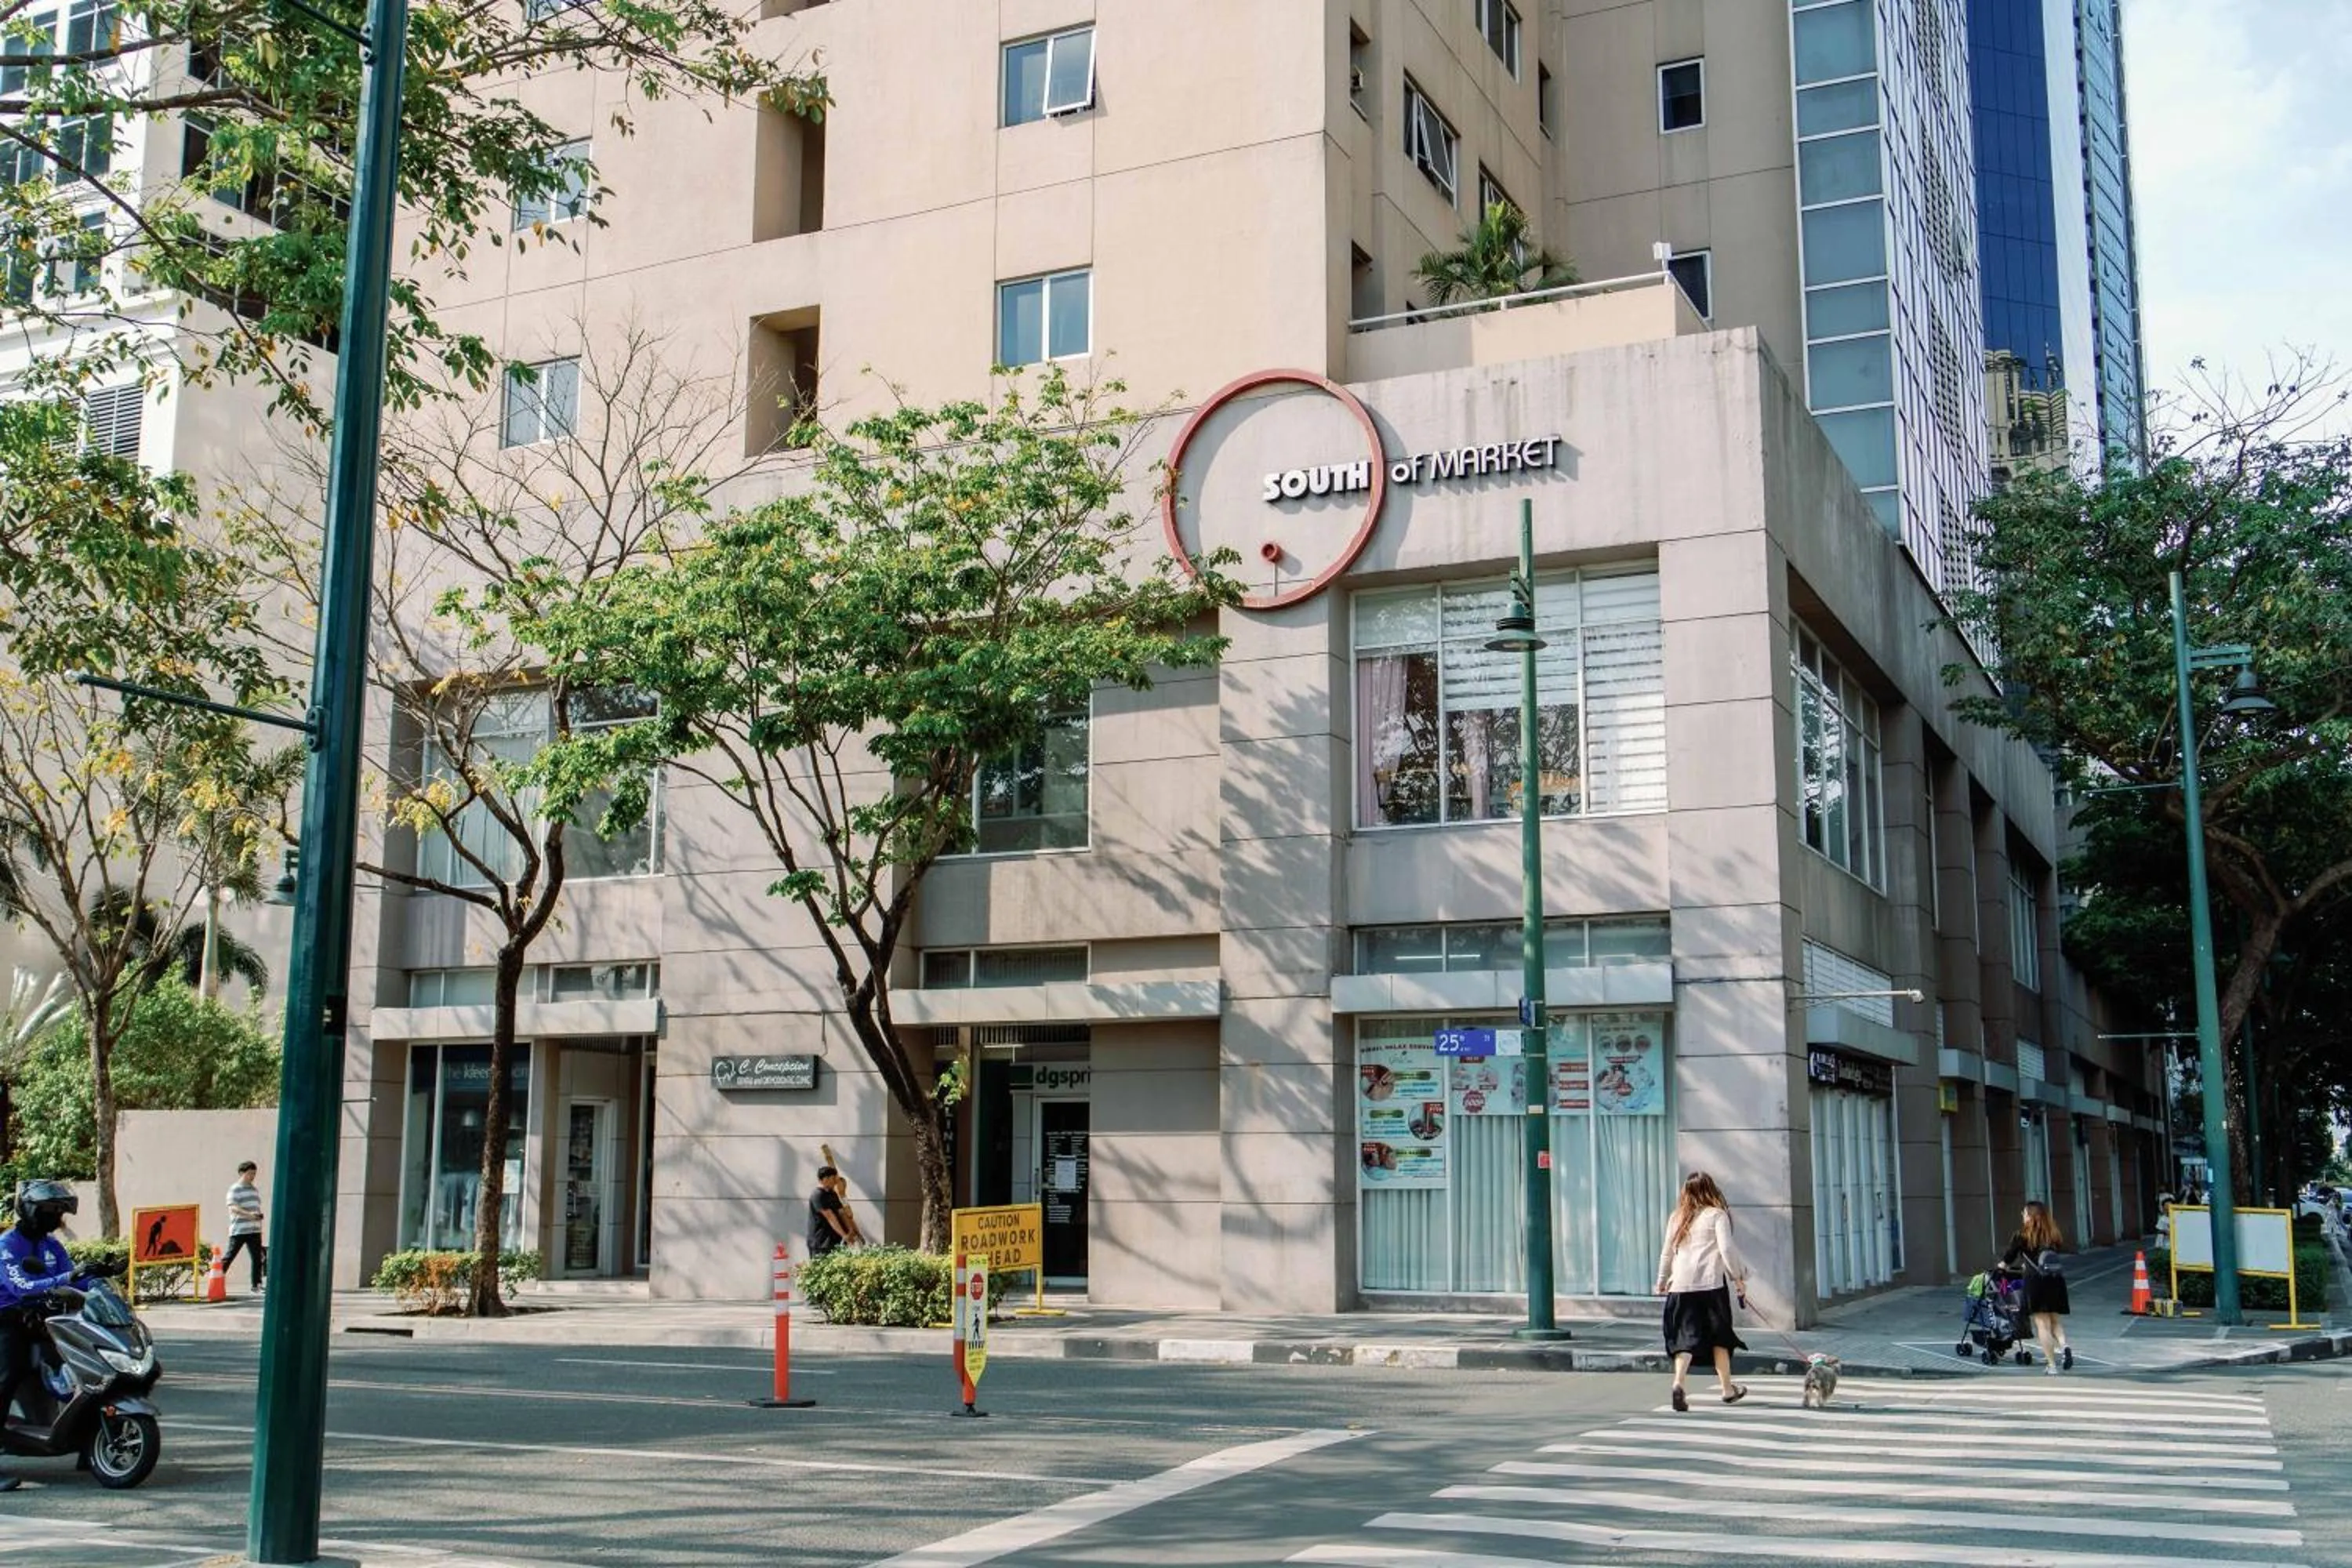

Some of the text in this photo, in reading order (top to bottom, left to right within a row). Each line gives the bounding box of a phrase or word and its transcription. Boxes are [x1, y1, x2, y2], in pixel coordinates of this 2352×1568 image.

[1262, 459, 1369, 502] SOUTH
[1430, 434, 1561, 480] MARKET
[978, 1214, 1020, 1230] CAUTION
[960, 1229, 1036, 1250] ROADWORK
[988, 1248, 1022, 1266] HEAD
